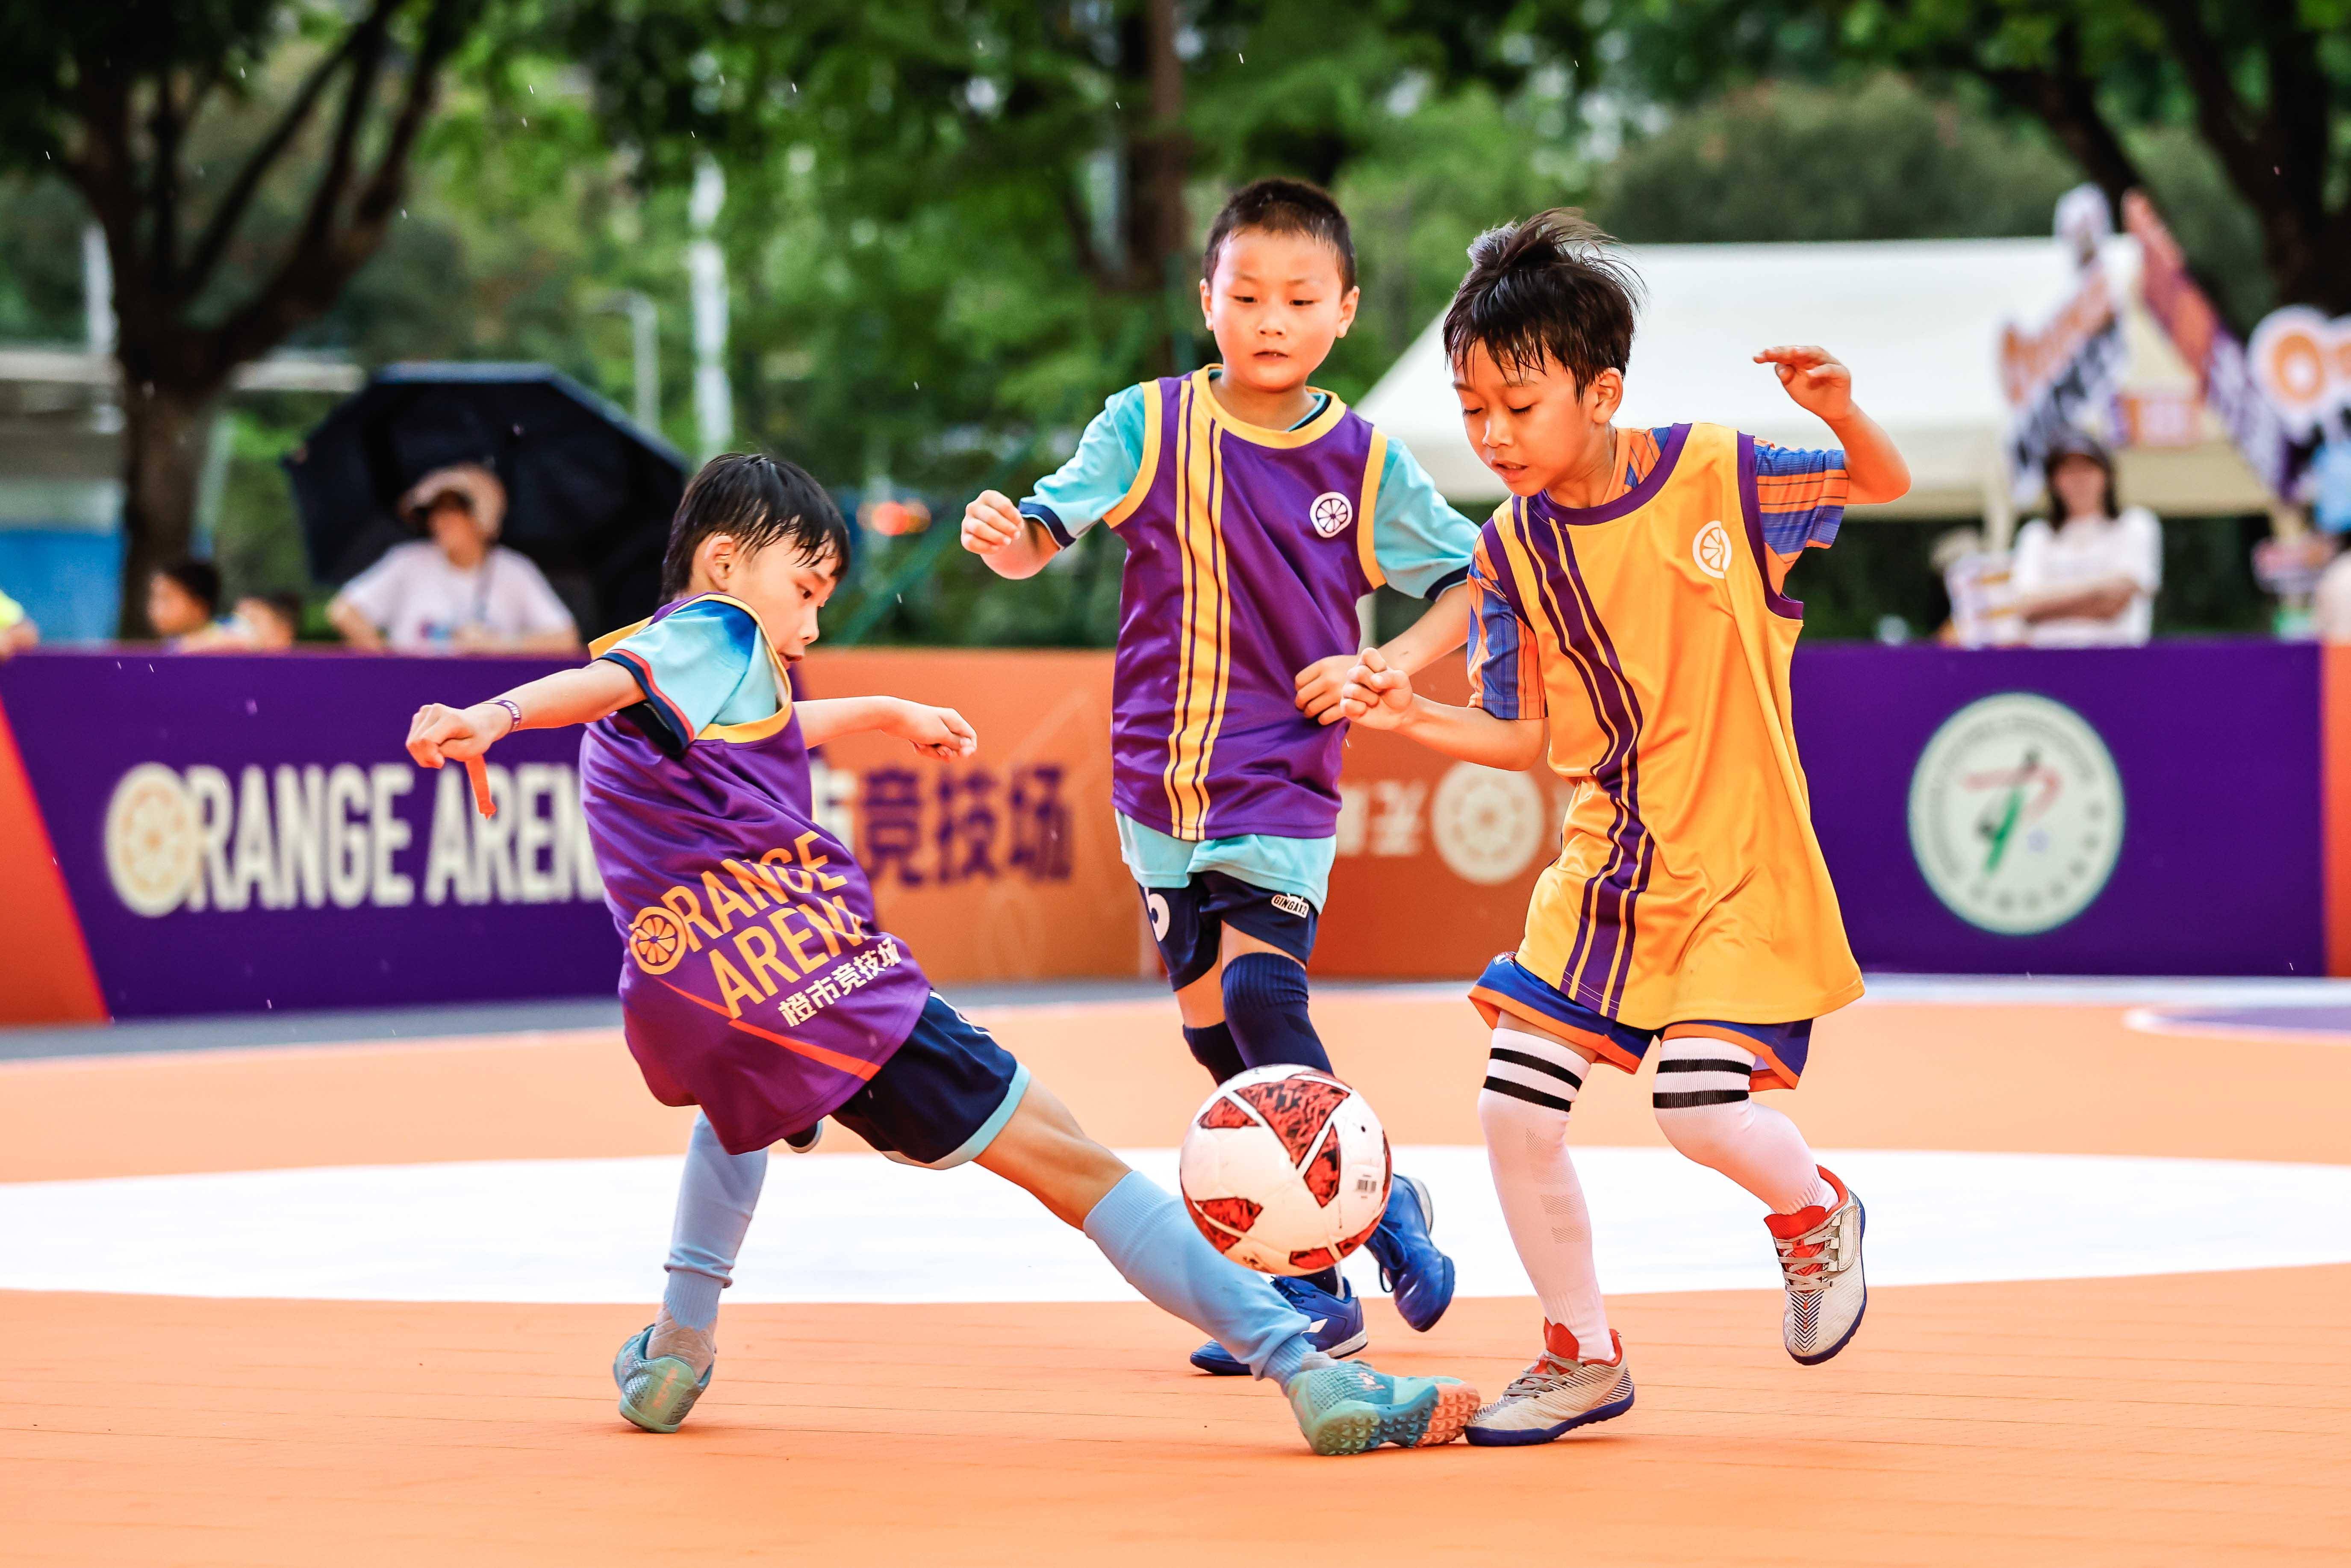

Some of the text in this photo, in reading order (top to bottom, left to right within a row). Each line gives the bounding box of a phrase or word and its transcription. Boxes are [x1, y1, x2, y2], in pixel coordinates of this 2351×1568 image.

[423, 763, 607, 905] AREN
[628, 830, 848, 975] ORANGE
[708, 895, 868, 1019] ARENA
[777, 937, 902, 1027] 橙市竞技场
